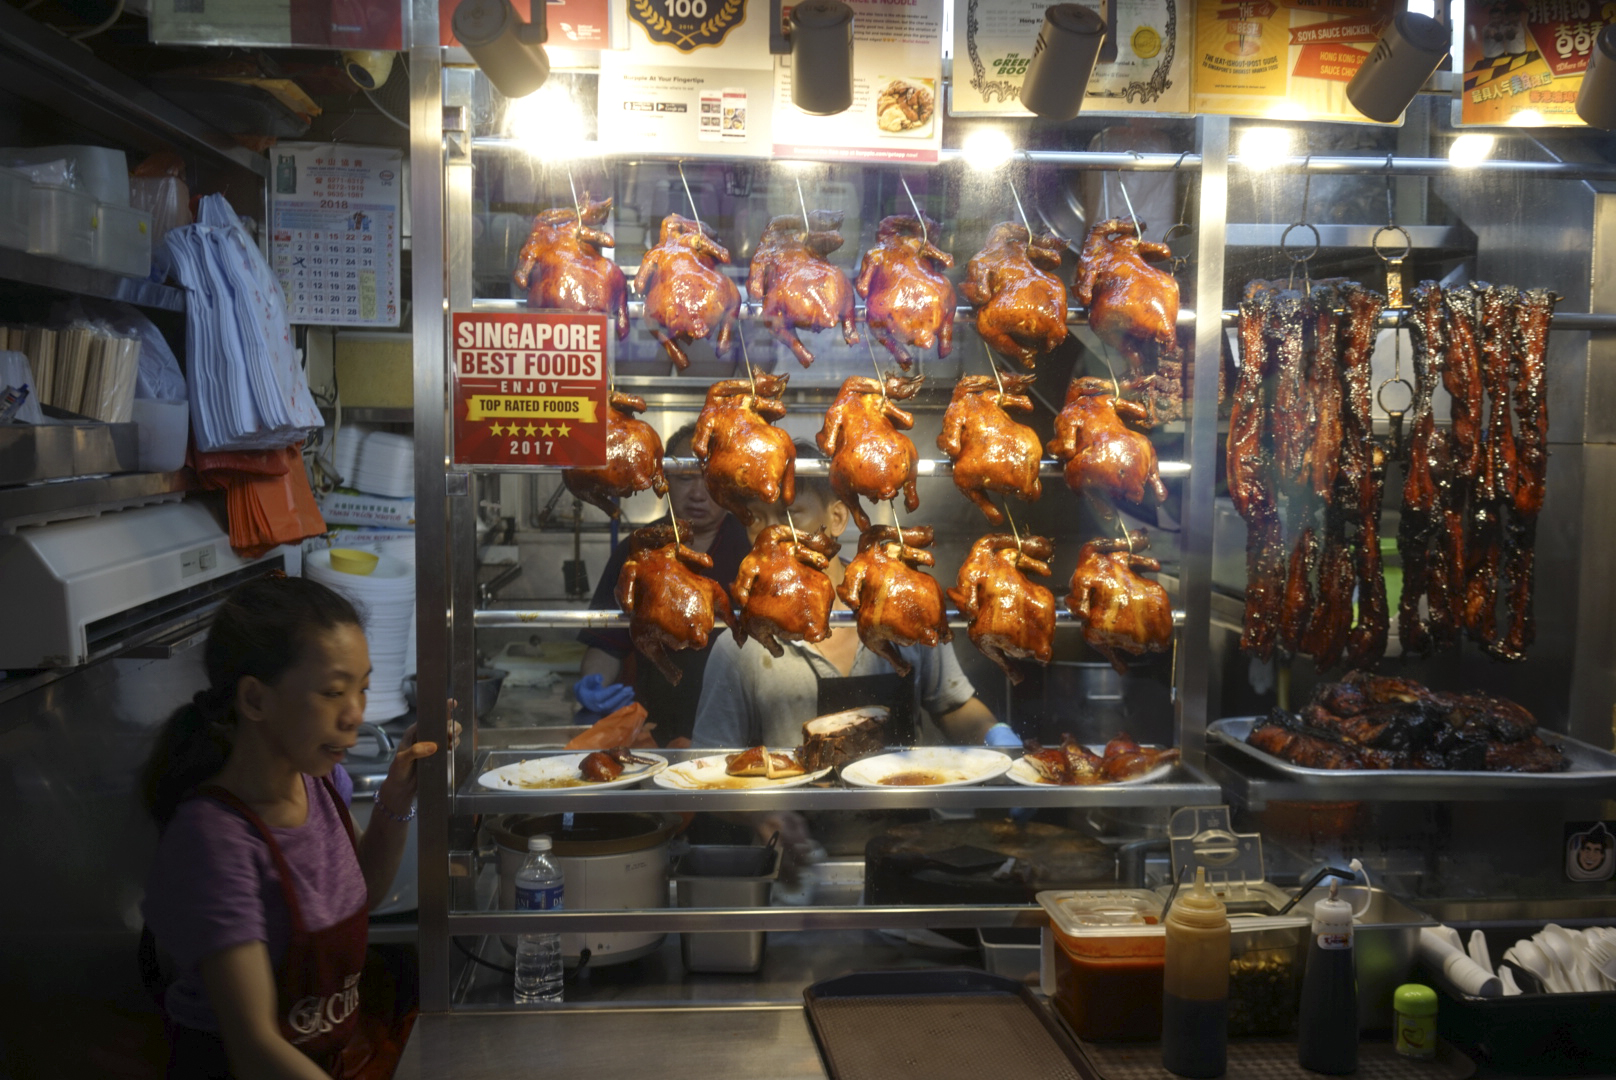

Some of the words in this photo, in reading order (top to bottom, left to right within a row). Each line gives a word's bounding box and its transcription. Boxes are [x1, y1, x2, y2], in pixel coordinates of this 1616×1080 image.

[664, 0, 707, 18] 100
[1238, 6, 1254, 17] THE
[1297, 31, 1317, 42] SOYA
[1318, 29, 1341, 40] SAUCE
[1342, 24, 1370, 38] CHICKEN
[1320, 52, 1337, 62] HONG
[1338, 53, 1356, 64] KONG
[997, 66, 1026, 75] BOO
[1320, 64, 1340, 76] SAUCE
[1342, 66, 1358, 78] CHIC
[673, 76, 704, 84] Fingertips
[320, 200, 348, 209] 2018
[458, 321, 600, 350] SINGAPORE
[461, 352, 517, 375] BEST
[525, 353, 596, 376] FOODS
[500, 381, 559, 394] ENJOY
[480, 399, 501, 411] TOP
[504, 399, 540, 412] RATED
[543, 400, 580, 412] FOODS
[510, 441, 554, 455] 2017
